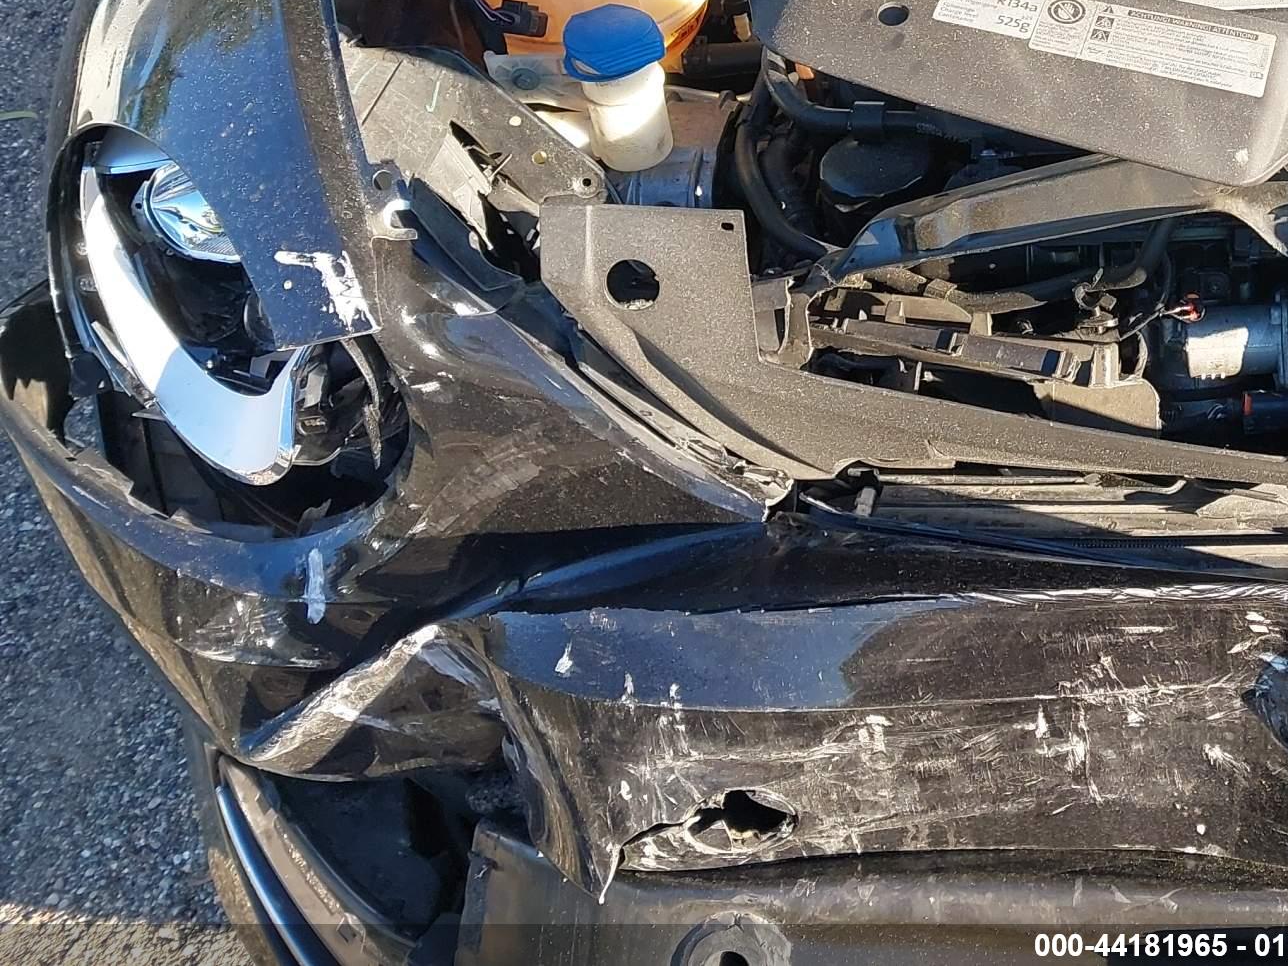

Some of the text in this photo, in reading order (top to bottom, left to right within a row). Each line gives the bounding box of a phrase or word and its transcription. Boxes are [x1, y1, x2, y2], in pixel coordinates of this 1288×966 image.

[995, 15, 1031, 33] 525g
[1172, 18, 1212, 32] WARNING!
[1212, 25, 1259, 40] ATTENTION!
